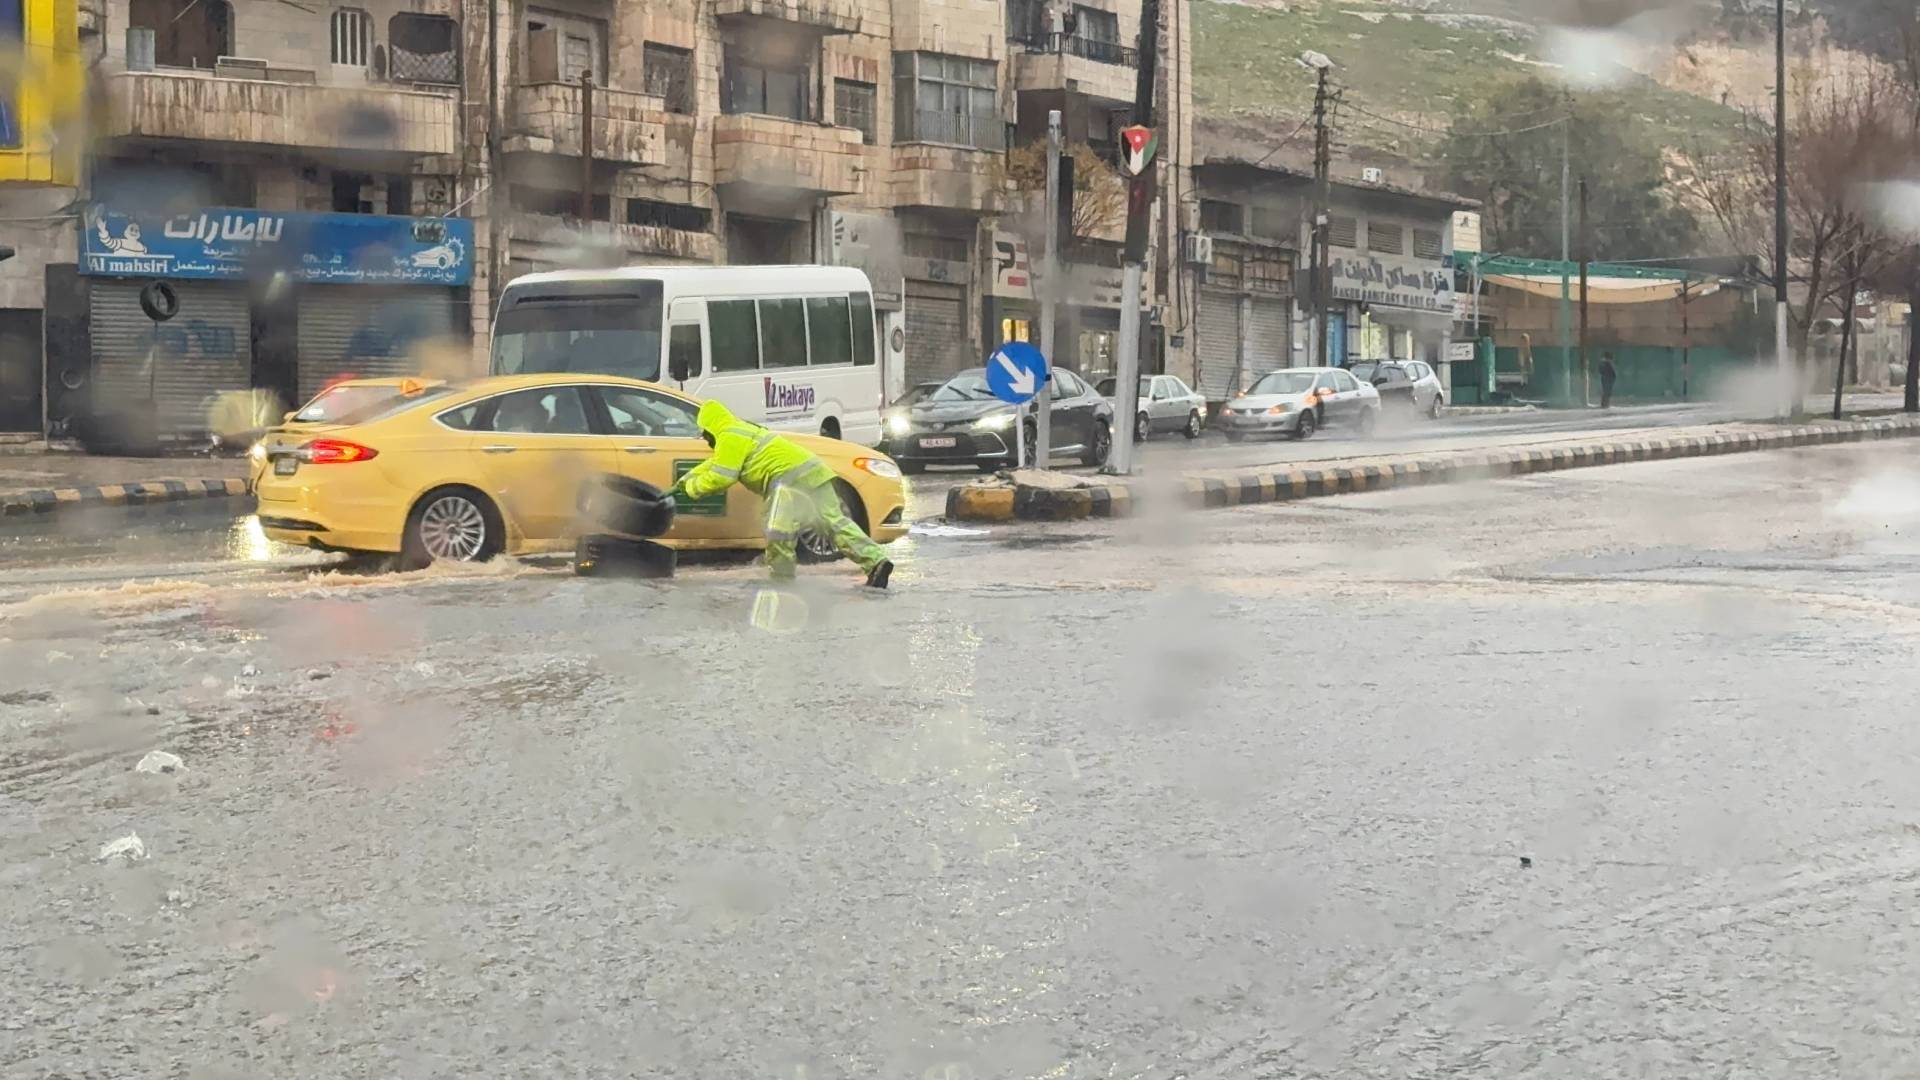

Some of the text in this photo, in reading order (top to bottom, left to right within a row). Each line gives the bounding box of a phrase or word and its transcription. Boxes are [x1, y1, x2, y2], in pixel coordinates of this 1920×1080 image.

[89, 257, 168, 273] Al mahsiri
[779, 384, 815, 412] Hakaya
